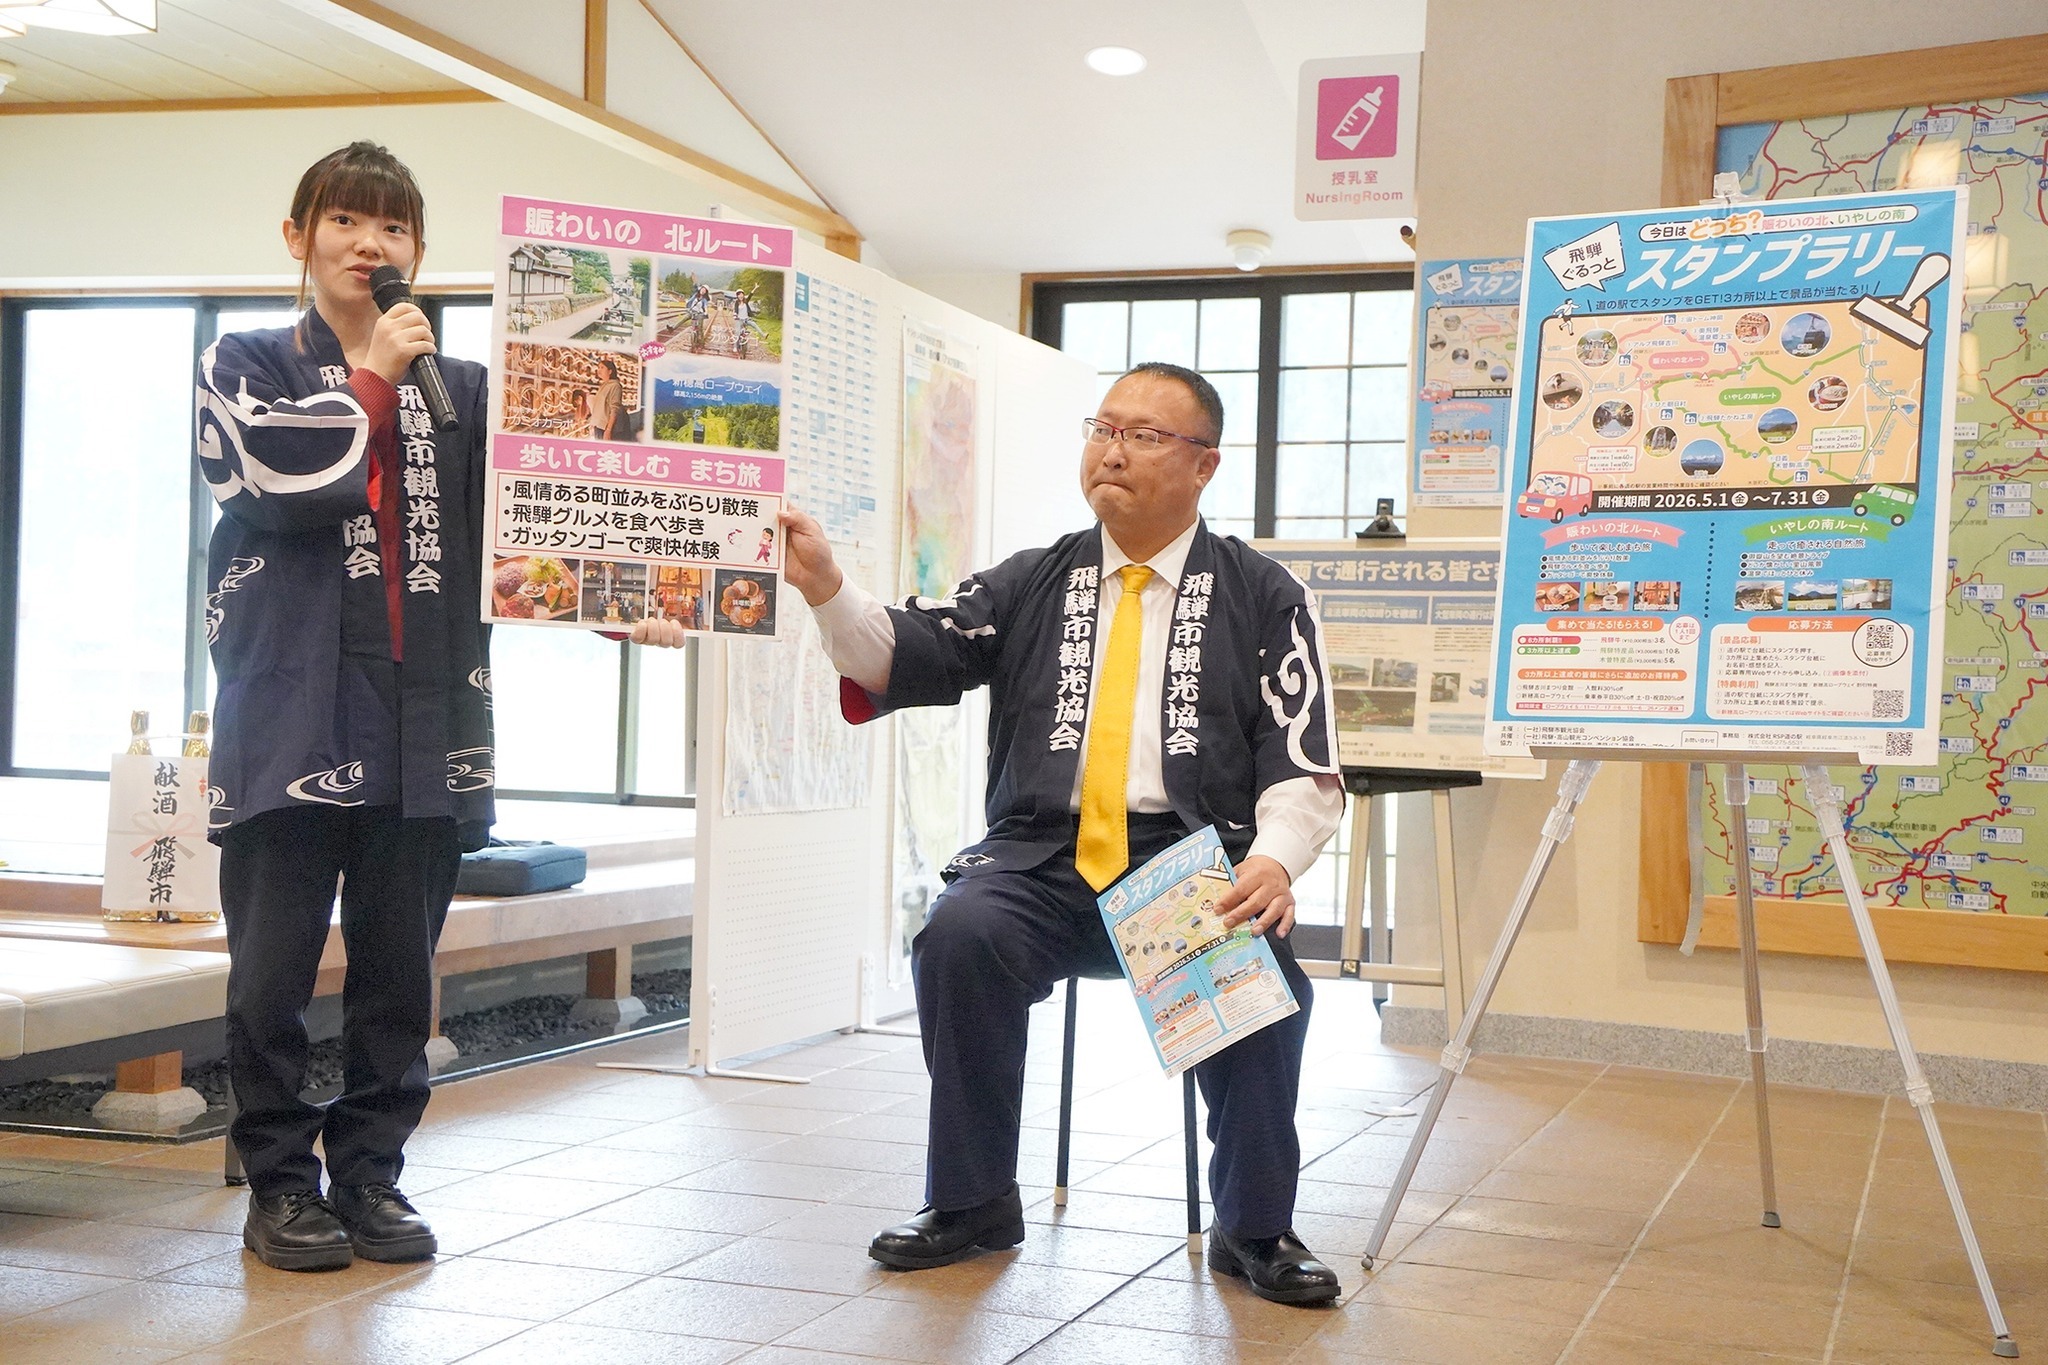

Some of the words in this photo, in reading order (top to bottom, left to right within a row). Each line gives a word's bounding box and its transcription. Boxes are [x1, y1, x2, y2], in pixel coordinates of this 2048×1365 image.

[1331, 171, 1379, 186] 授乳室
[1306, 190, 1404, 205] NursingRoom
[525, 207, 641, 246] 賑わいの
[664, 223, 773, 260] 北ルート
[1569, 242, 1602, 264] 飛騨
[1626, 230, 1925, 292] スタンプラリー
[1562, 257, 1617, 281] ぐるっと
[640, 345, 666, 357] おすすめ
[1653, 356, 1706, 365] 賑わいの北ルート
[1724, 391, 1777, 400] いやしの南ルート
[519, 443, 671, 479] 歩いて楽しむ
[690, 459, 763, 489] まち旅
[397, 384, 442, 594] 飛騨市観光協会
[1598, 495, 1650, 508] 開催期間
[1655, 493, 1728, 508] 2026.5.1
[1566, 522, 1661, 538] 賑わいの北ルート
[1770, 519, 1868, 534] いやしの南ルート
[343, 514, 381, 579] 協会
[1557, 619, 1653, 630] 集めて当たる!もらえる!
[1788, 620, 1833, 630] 応募方法
[1048, 564, 1100, 752] 飛騨市観光協会
[1165, 571, 1215, 756] 飛騨市観光協会
[152, 761, 181, 816] 献酒
[143, 836, 178, 906] 飛騨市
[1131, 844, 1214, 905] スタンプラリー
